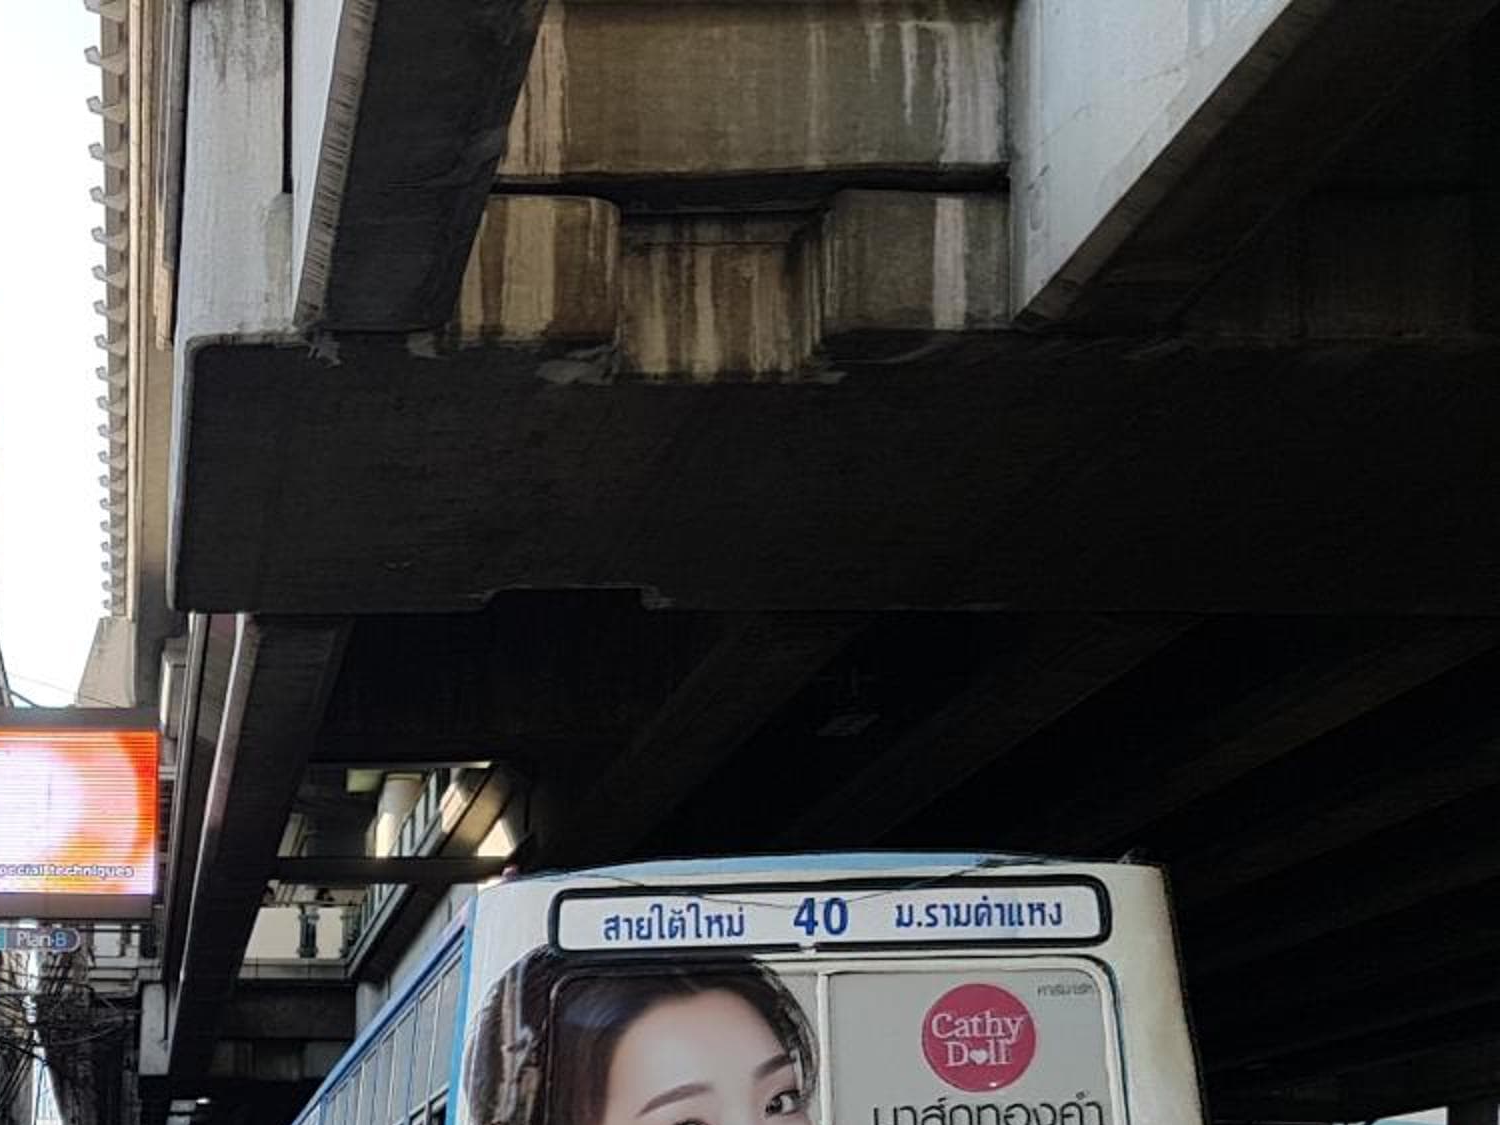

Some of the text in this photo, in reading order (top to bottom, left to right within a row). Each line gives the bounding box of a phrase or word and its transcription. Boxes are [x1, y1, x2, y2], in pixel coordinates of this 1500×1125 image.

[603, 902, 745, 940] สายใต้ใหม่
[793, 897, 849, 936] 40
[895, 895, 1063, 928] ม.รามคำแหง
[931, 1011, 1025, 1044] Cathy
